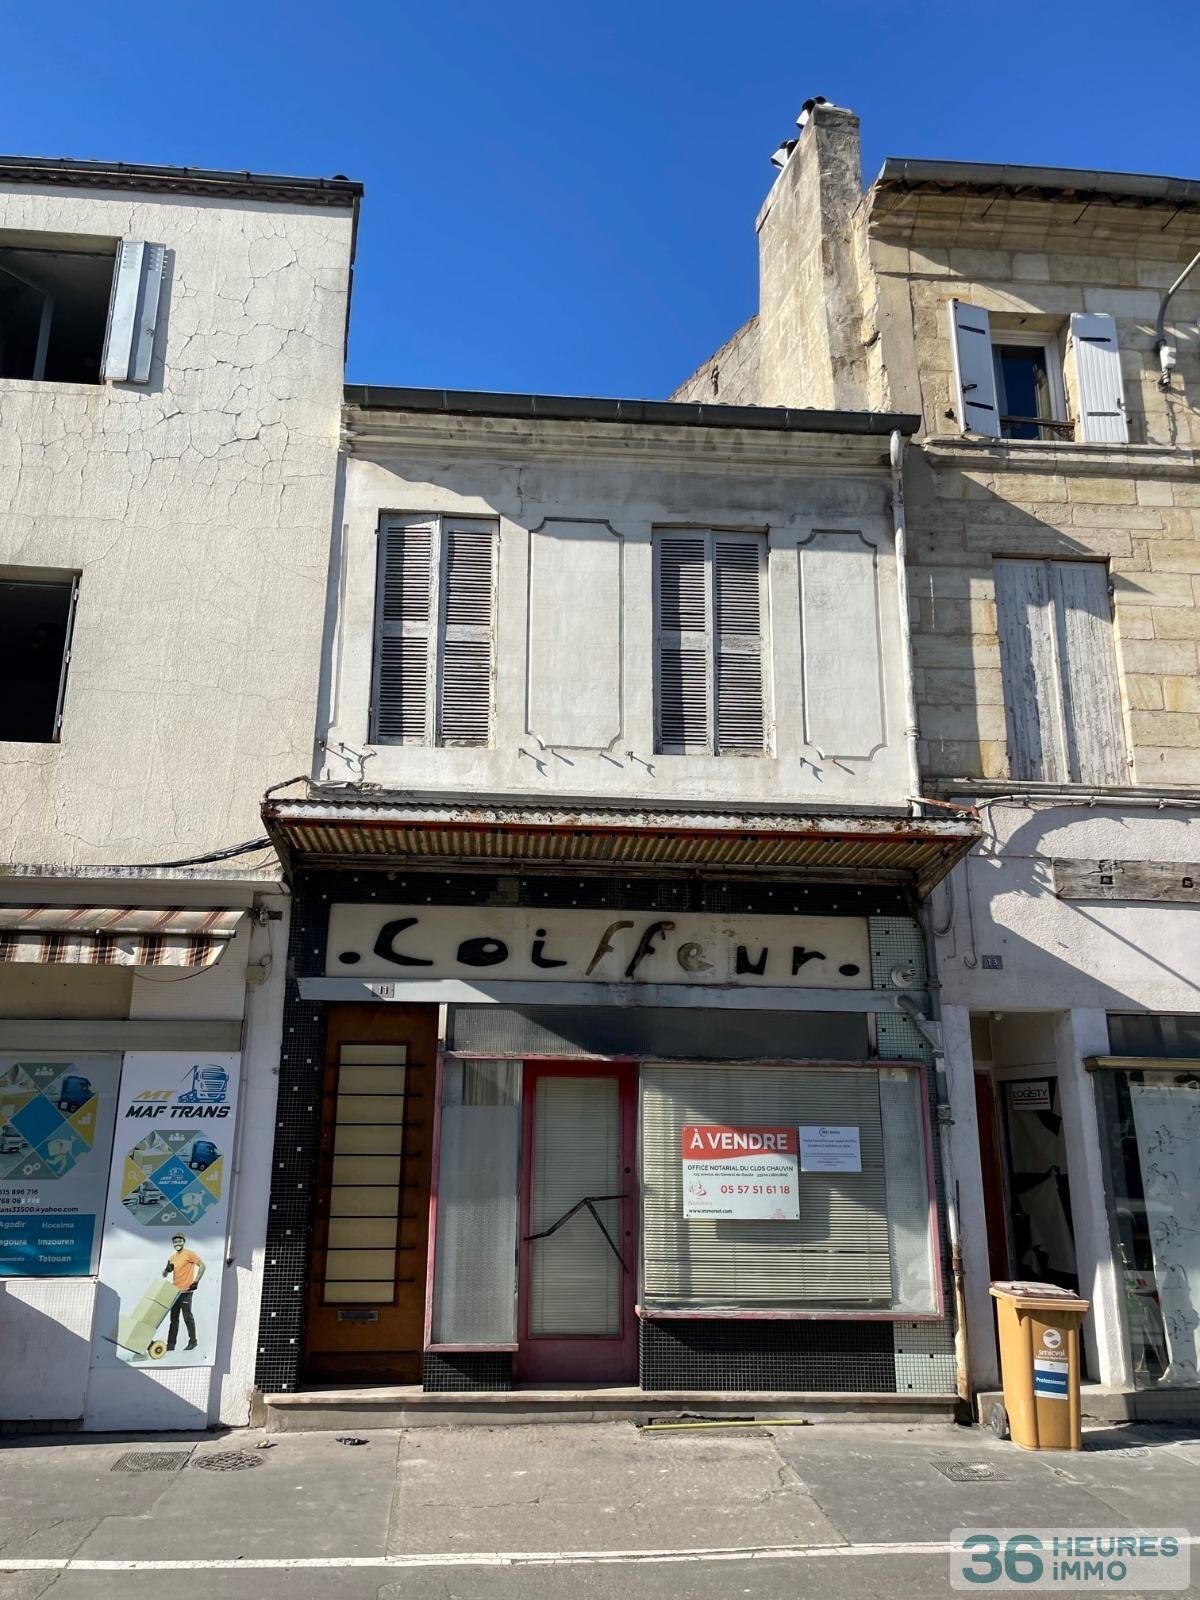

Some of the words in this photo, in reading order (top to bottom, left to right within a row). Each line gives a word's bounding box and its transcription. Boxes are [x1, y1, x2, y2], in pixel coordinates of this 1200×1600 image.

[987, 958, 998, 966] 13
[125, 1105, 167, 1118] MAF
[170, 1105, 231, 1118] TRANS
[690, 1128, 704, 1149] À
[706, 1132, 788, 1150] VENDRE
[720, 1185, 734, 1194] 05
[737, 1185, 749, 1194] 57
[752, 1185, 763, 1194] 51
[766, 1185, 777, 1194] 61
[779, 1185, 790, 1194] 18
[39, 1255, 72, 1263] Tetouan
